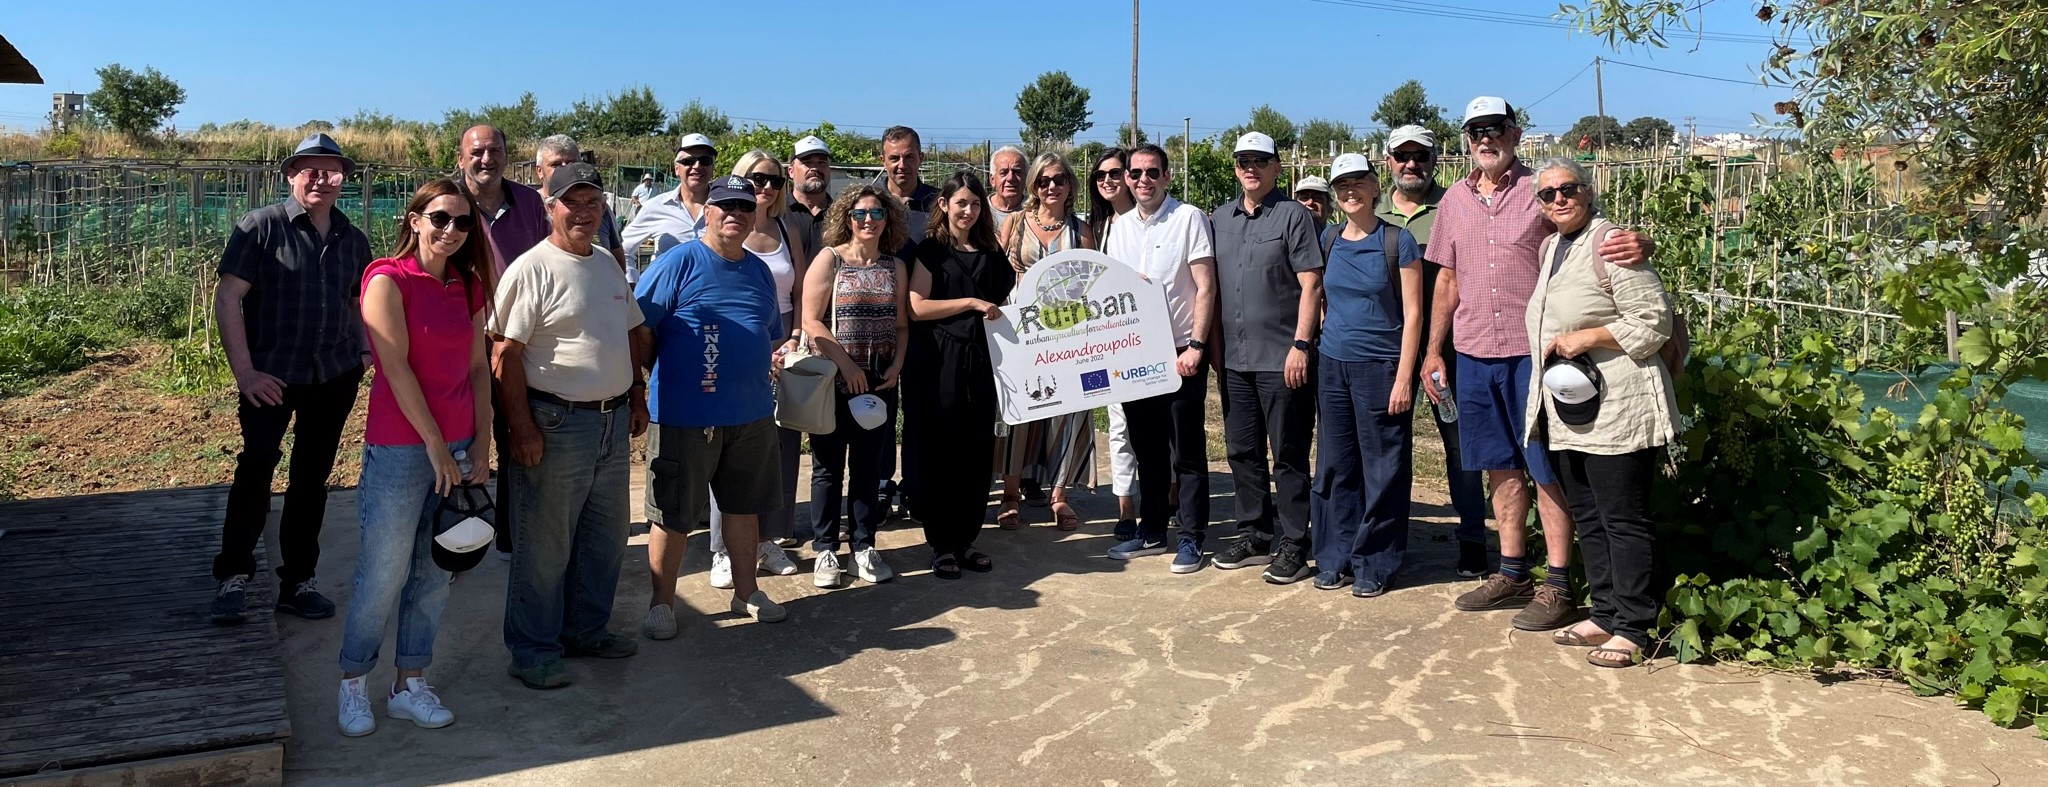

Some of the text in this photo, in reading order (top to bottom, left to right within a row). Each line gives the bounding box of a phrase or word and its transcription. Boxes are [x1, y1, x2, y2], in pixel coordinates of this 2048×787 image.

[702, 333, 720, 373] NAVY
[1034, 333, 1142, 366] Alexandroupolis
[1075, 354, 1104, 366] June 2022
[1121, 362, 1167, 380] URBACT
